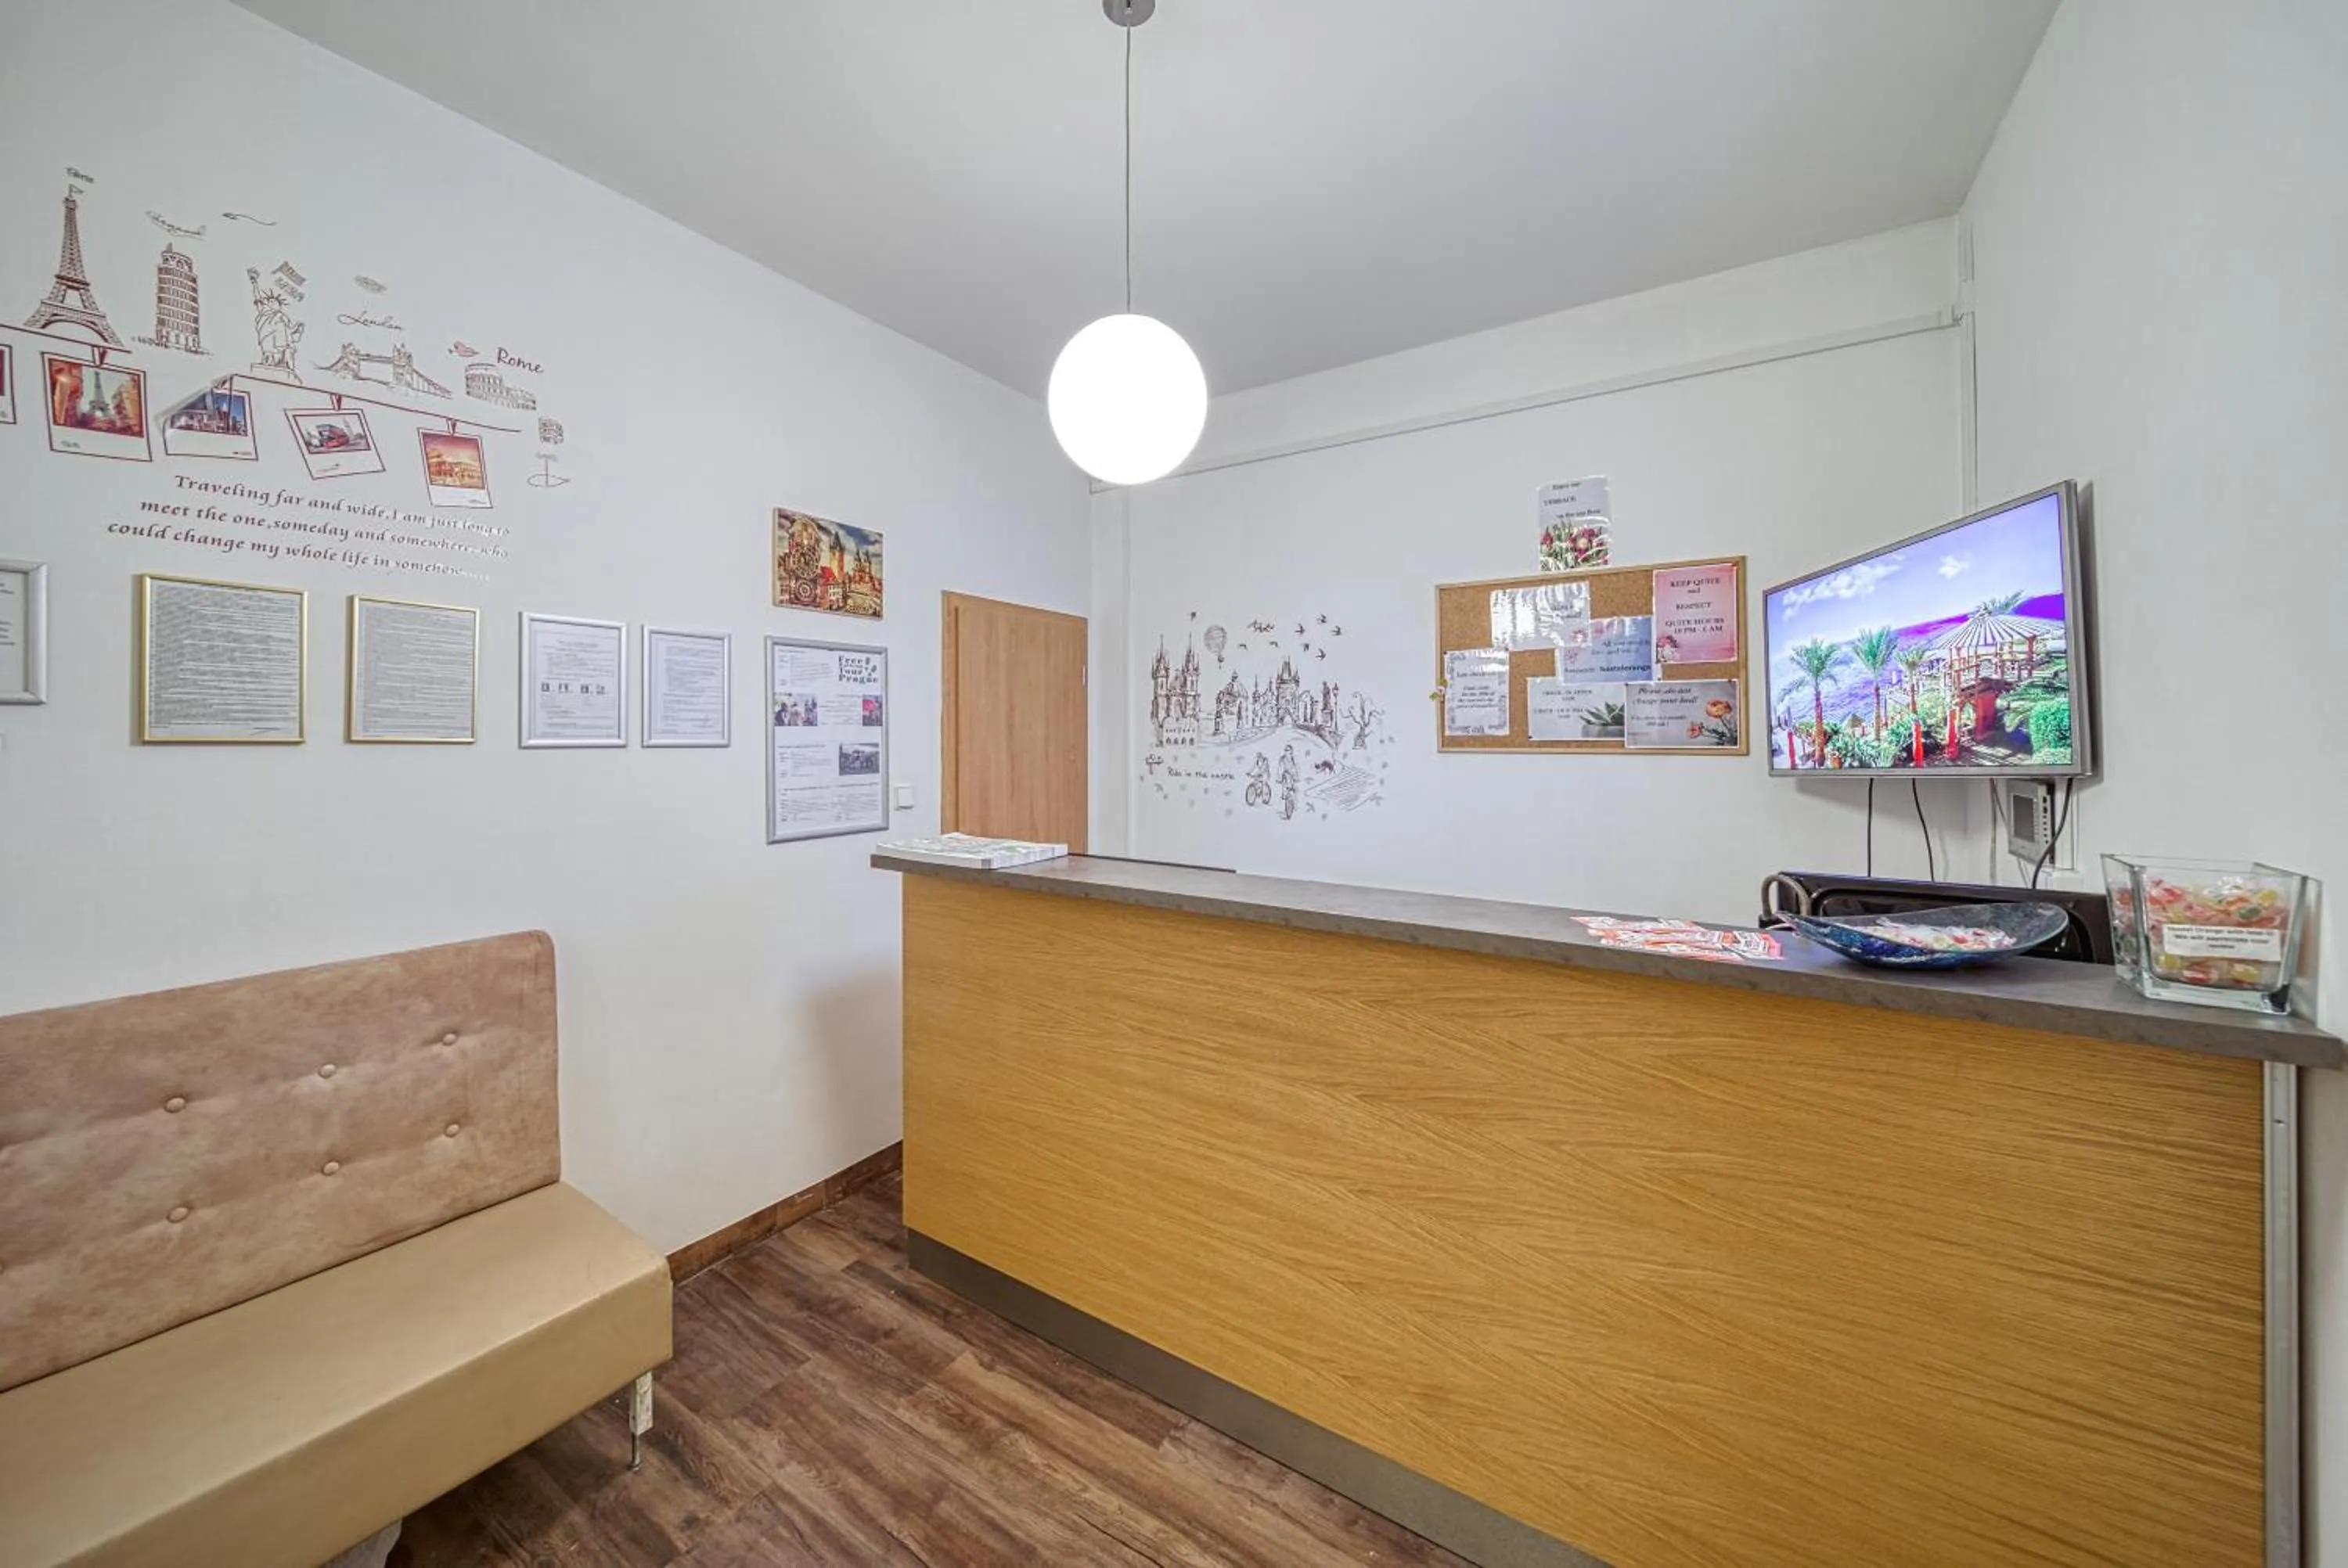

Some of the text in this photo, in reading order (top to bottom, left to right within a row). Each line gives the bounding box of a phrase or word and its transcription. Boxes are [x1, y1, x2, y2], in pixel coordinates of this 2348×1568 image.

[497, 347, 544, 373] Rome
[175, 475, 271, 505] Traveling
[270, 489, 304, 508] far
[308, 498, 345, 512] and
[402, 512, 426, 524] am
[140, 502, 190, 517] meet
[196, 505, 228, 523] the
[355, 529, 390, 542] and
[107, 522, 171, 540] could
[173, 528, 245, 553] change
[250, 541, 279, 559] my
[285, 543, 337, 561] whole
[341, 548, 369, 569] life
[373, 554, 391, 568] in
